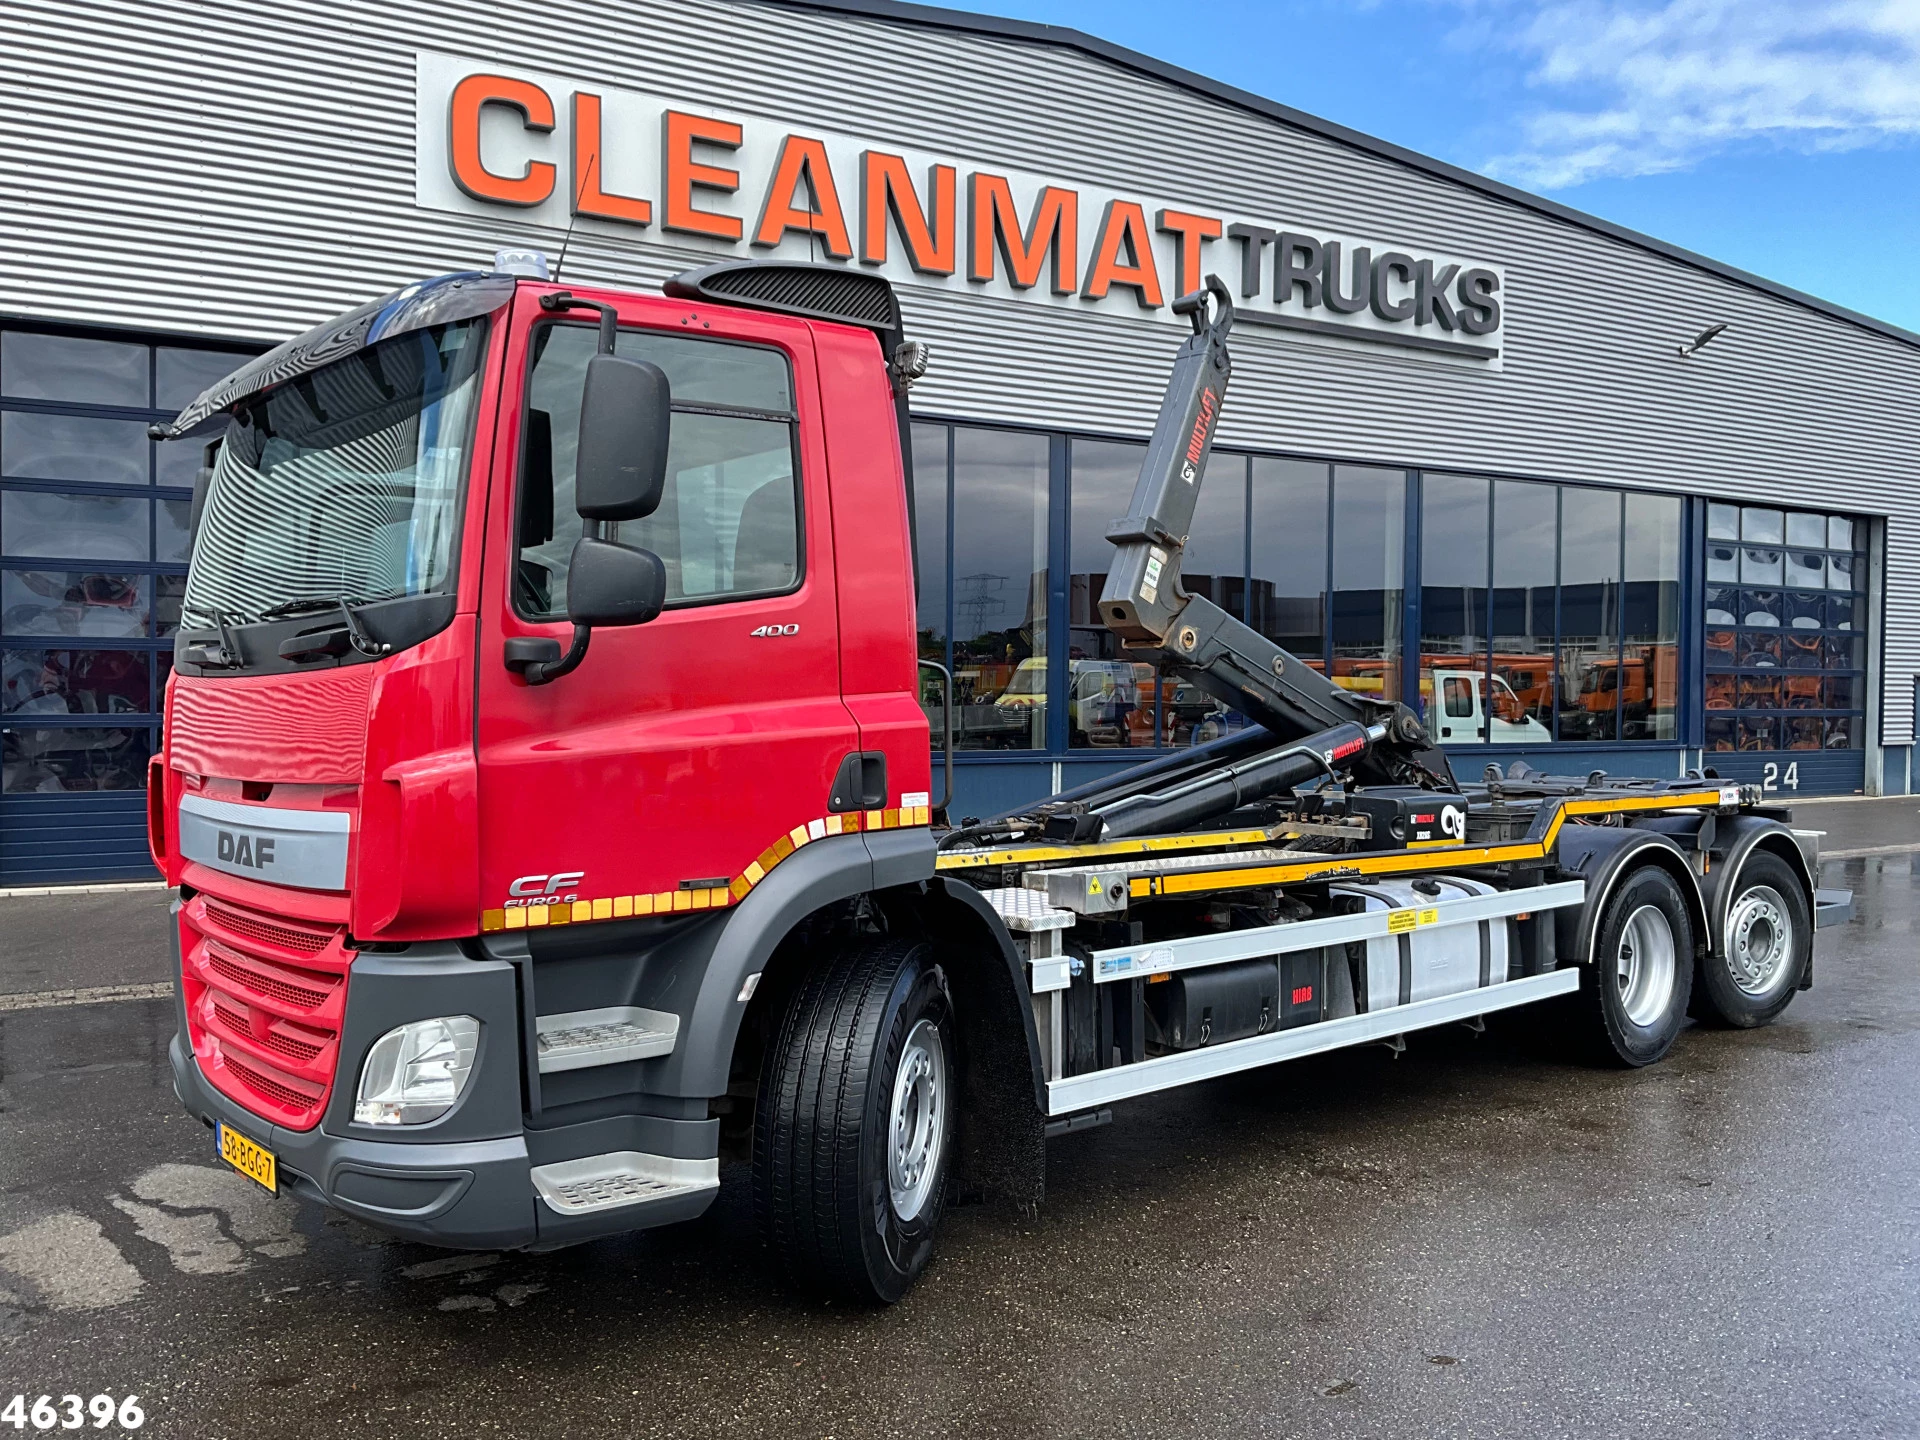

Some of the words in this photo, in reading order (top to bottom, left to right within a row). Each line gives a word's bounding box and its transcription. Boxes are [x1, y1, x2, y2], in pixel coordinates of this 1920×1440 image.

[449, 73, 1222, 309] CLEANMAT
[1228, 222, 1500, 335] TRUCKS
[750, 623, 799, 638] 400
[1763, 762, 1799, 791] 24
[217, 830, 275, 869] DAF
[509, 872, 585, 896] CF
[504, 896, 559, 908] EURO
[564, 894, 577, 903] 6
[1292, 986, 1312, 1004] HIAB
[224, 1131, 271, 1182] 58-BGG-7
